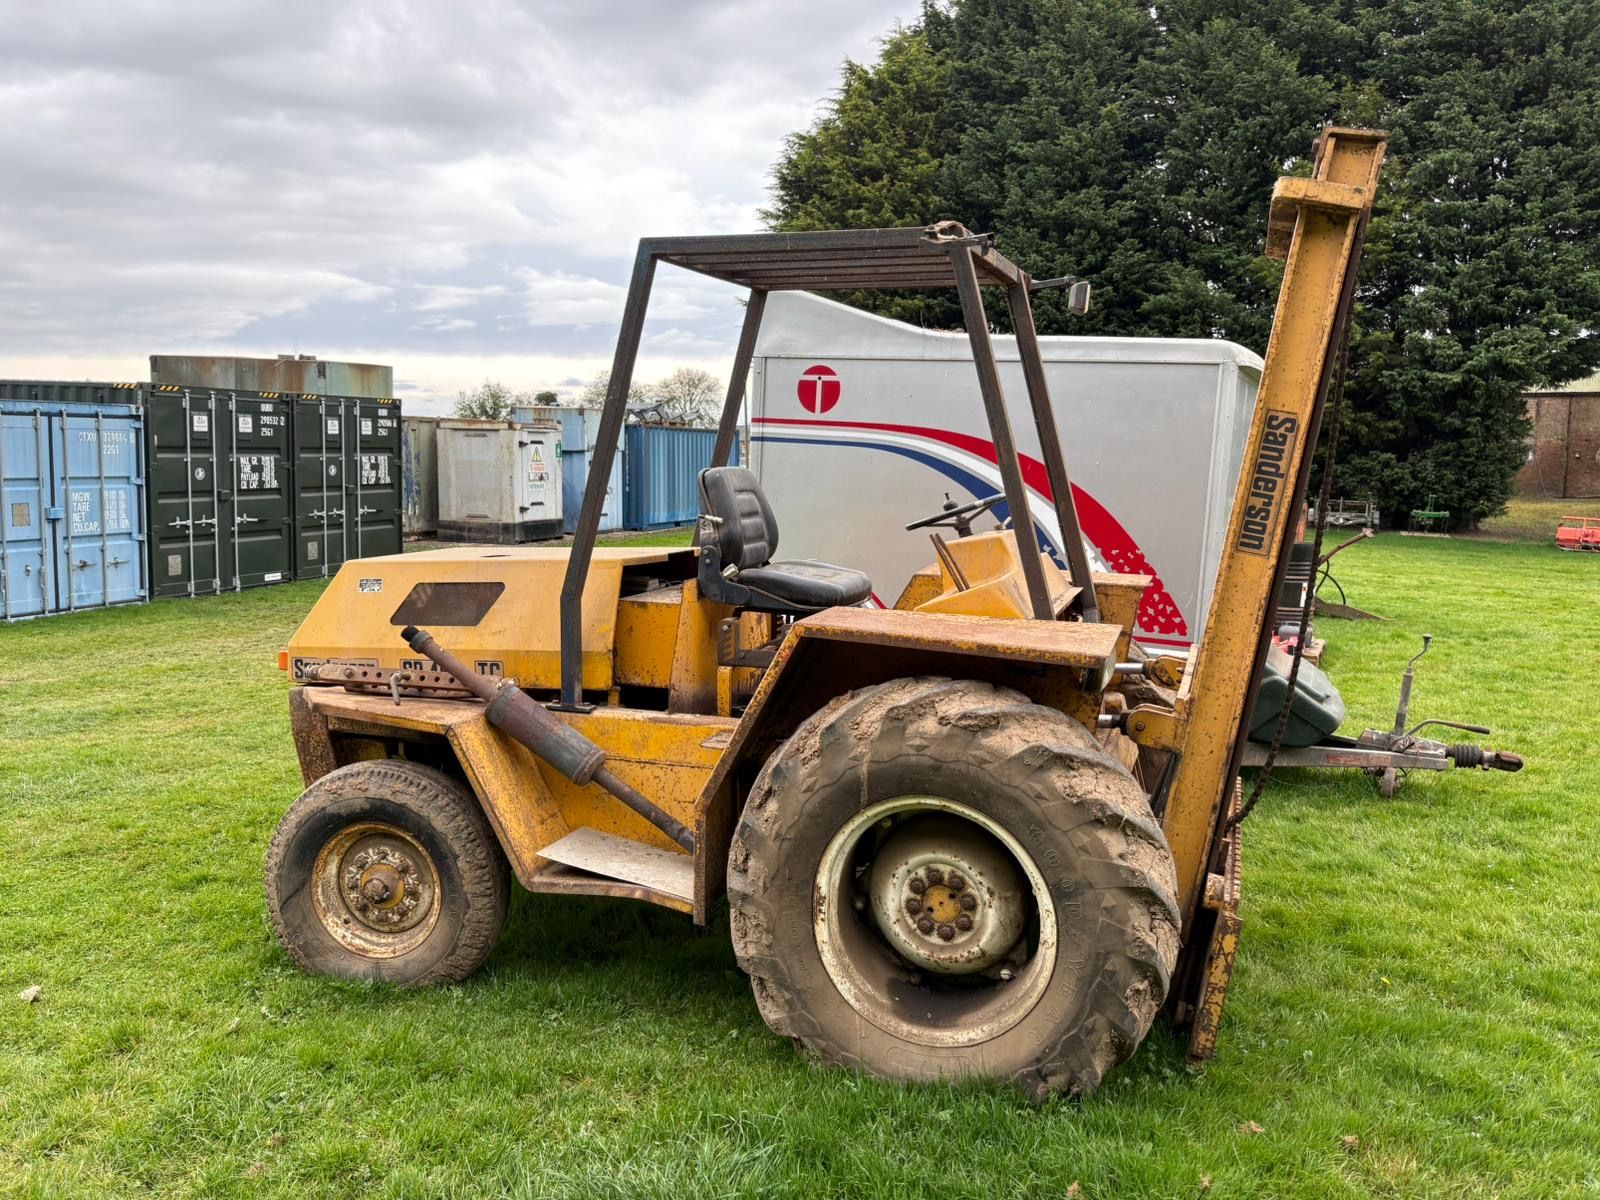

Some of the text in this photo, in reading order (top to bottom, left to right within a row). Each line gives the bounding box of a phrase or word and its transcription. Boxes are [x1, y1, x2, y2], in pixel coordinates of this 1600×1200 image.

[1239, 414, 1297, 550] Sanderson
[72, 502, 91, 512] TARE
[72, 512, 86, 522] NET
